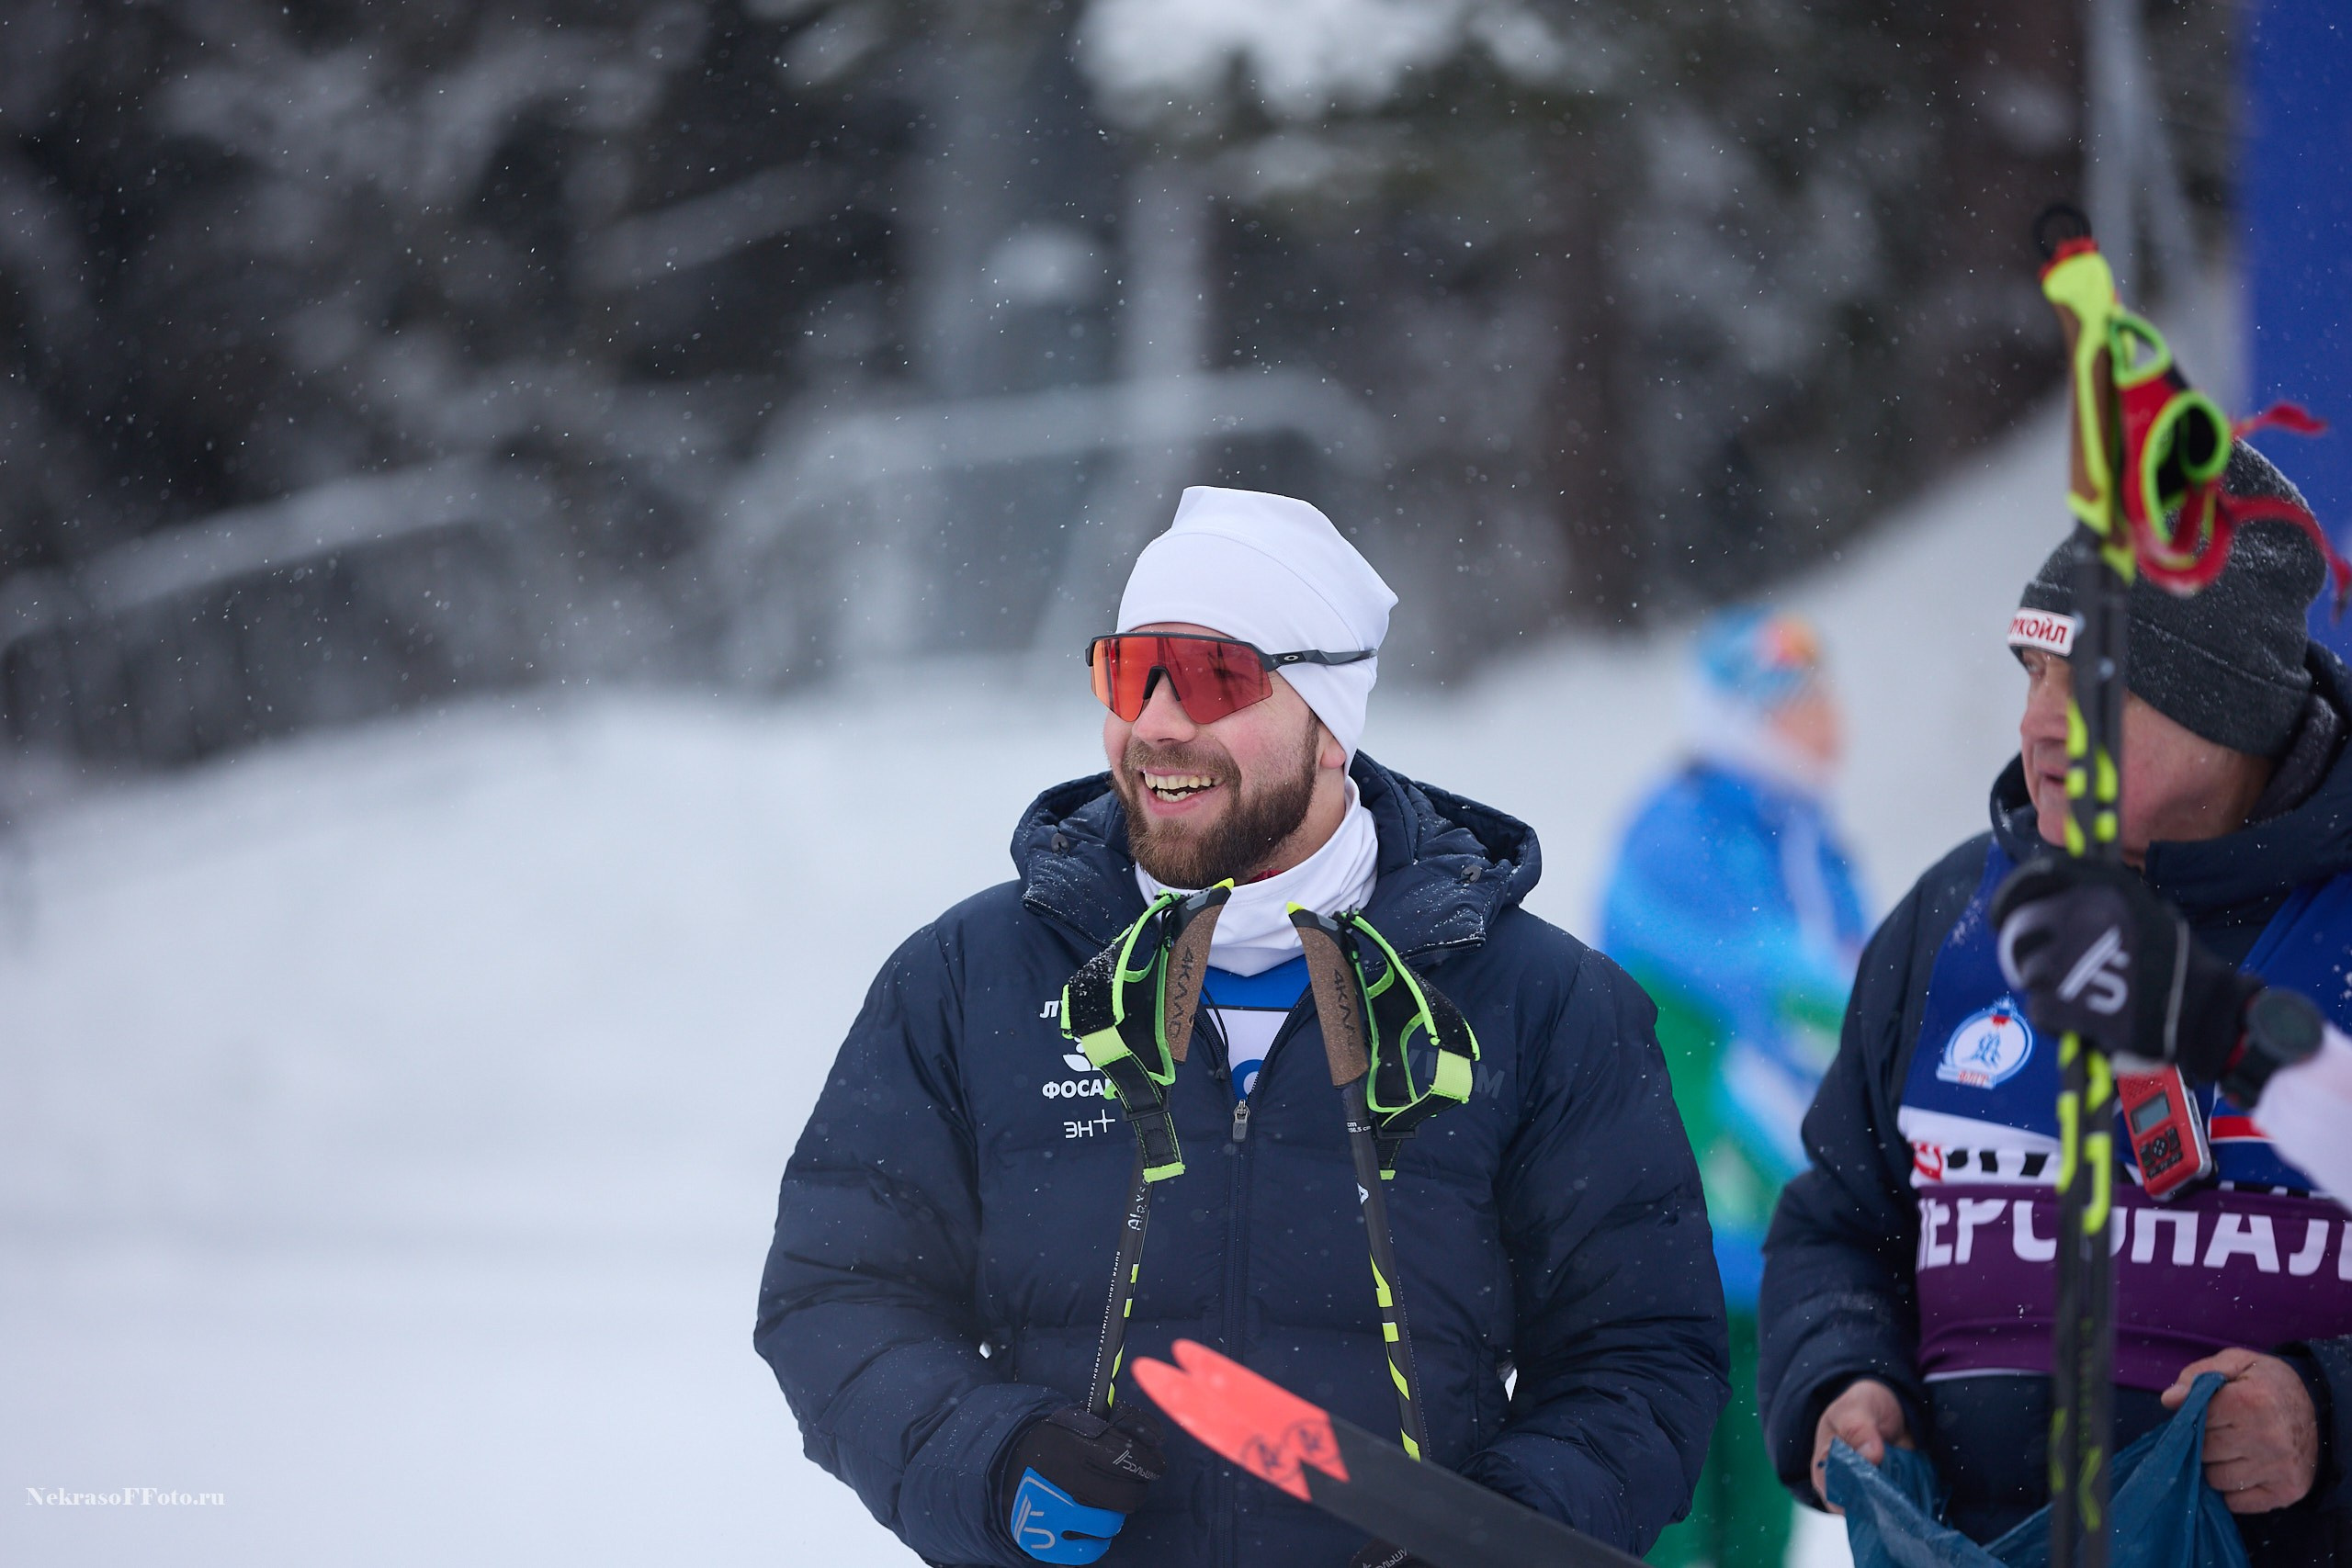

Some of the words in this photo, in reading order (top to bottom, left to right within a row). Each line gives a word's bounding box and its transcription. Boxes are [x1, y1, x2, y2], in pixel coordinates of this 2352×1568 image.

[1042, 1078, 1112, 1100] ФОСА
[1100, 1305, 1111, 1344] ULTIMATE
[1092, 1347, 1102, 1380] CARBON
